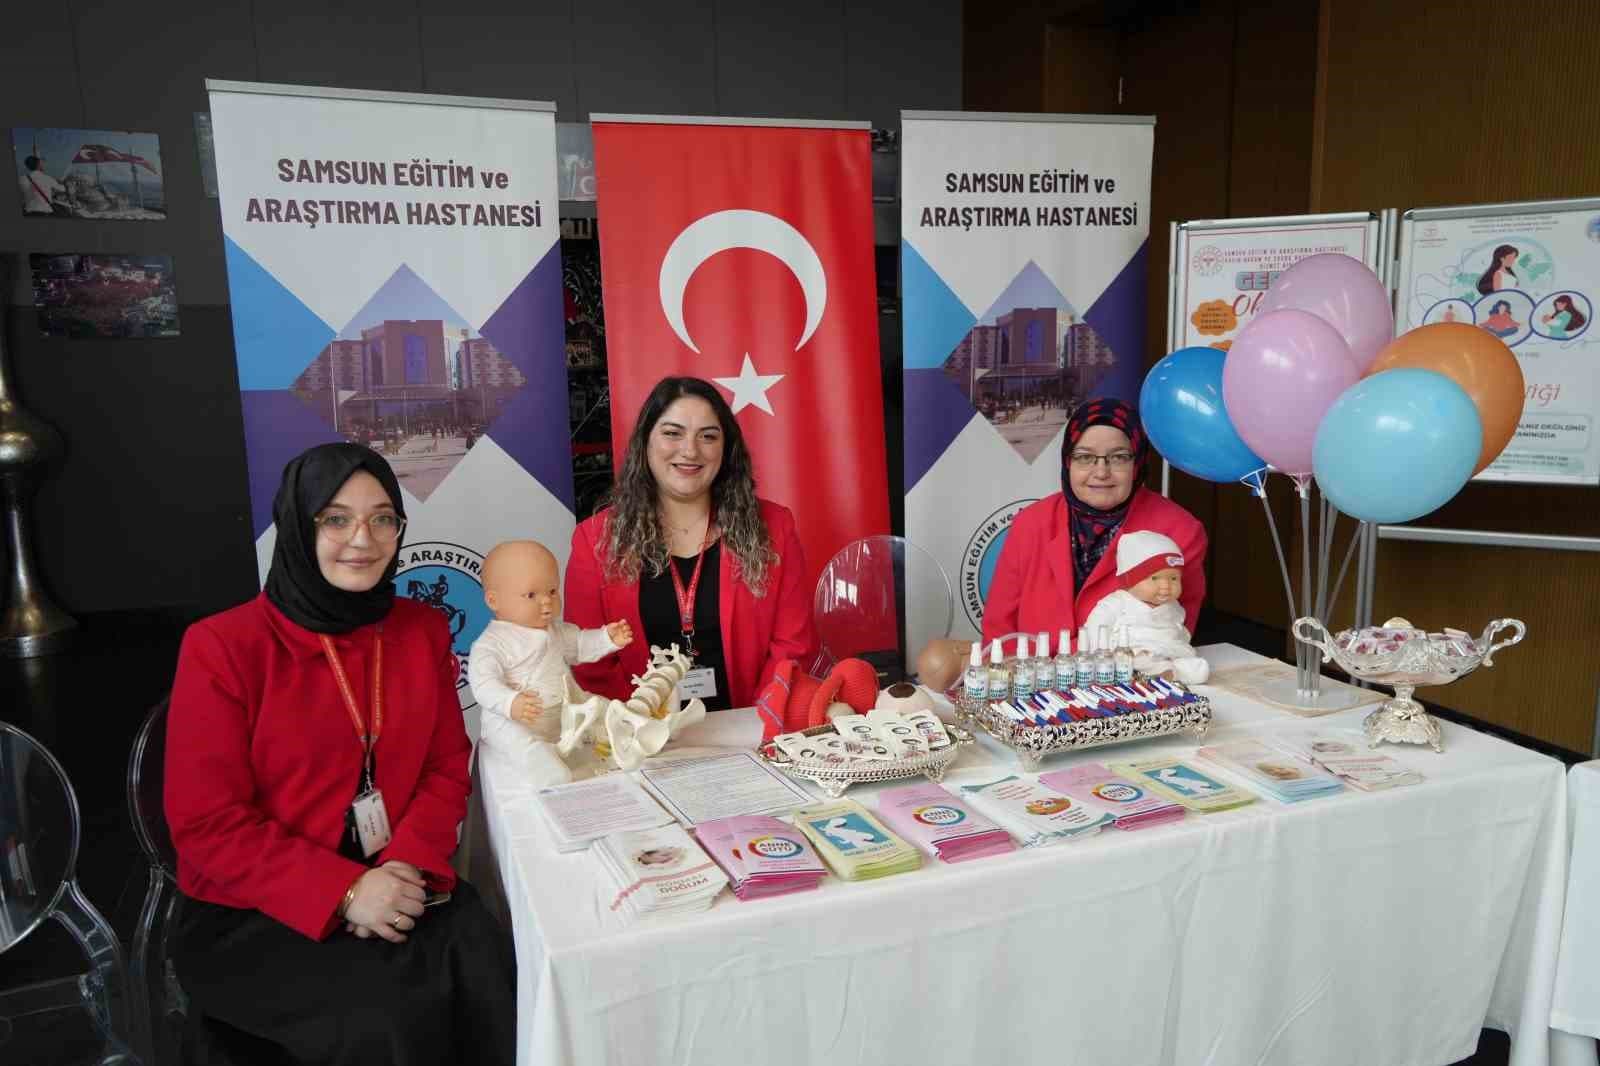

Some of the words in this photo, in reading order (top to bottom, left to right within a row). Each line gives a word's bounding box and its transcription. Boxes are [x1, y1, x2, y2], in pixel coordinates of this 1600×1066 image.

[278, 158, 386, 186] SAMSUN
[394, 159, 474, 188] EĞİTİM
[481, 171, 509, 188] ve
[946, 172, 1024, 193] SAMSUN
[1029, 169, 1089, 194] EĞİTİM
[1094, 178, 1116, 193] ve
[246, 198, 400, 229] ARAŞTIRMA
[406, 200, 541, 228] HASTANESİ
[920, 207, 1031, 231] ARAŞTIRMA
[1036, 203, 1138, 227] HASTANESİ
